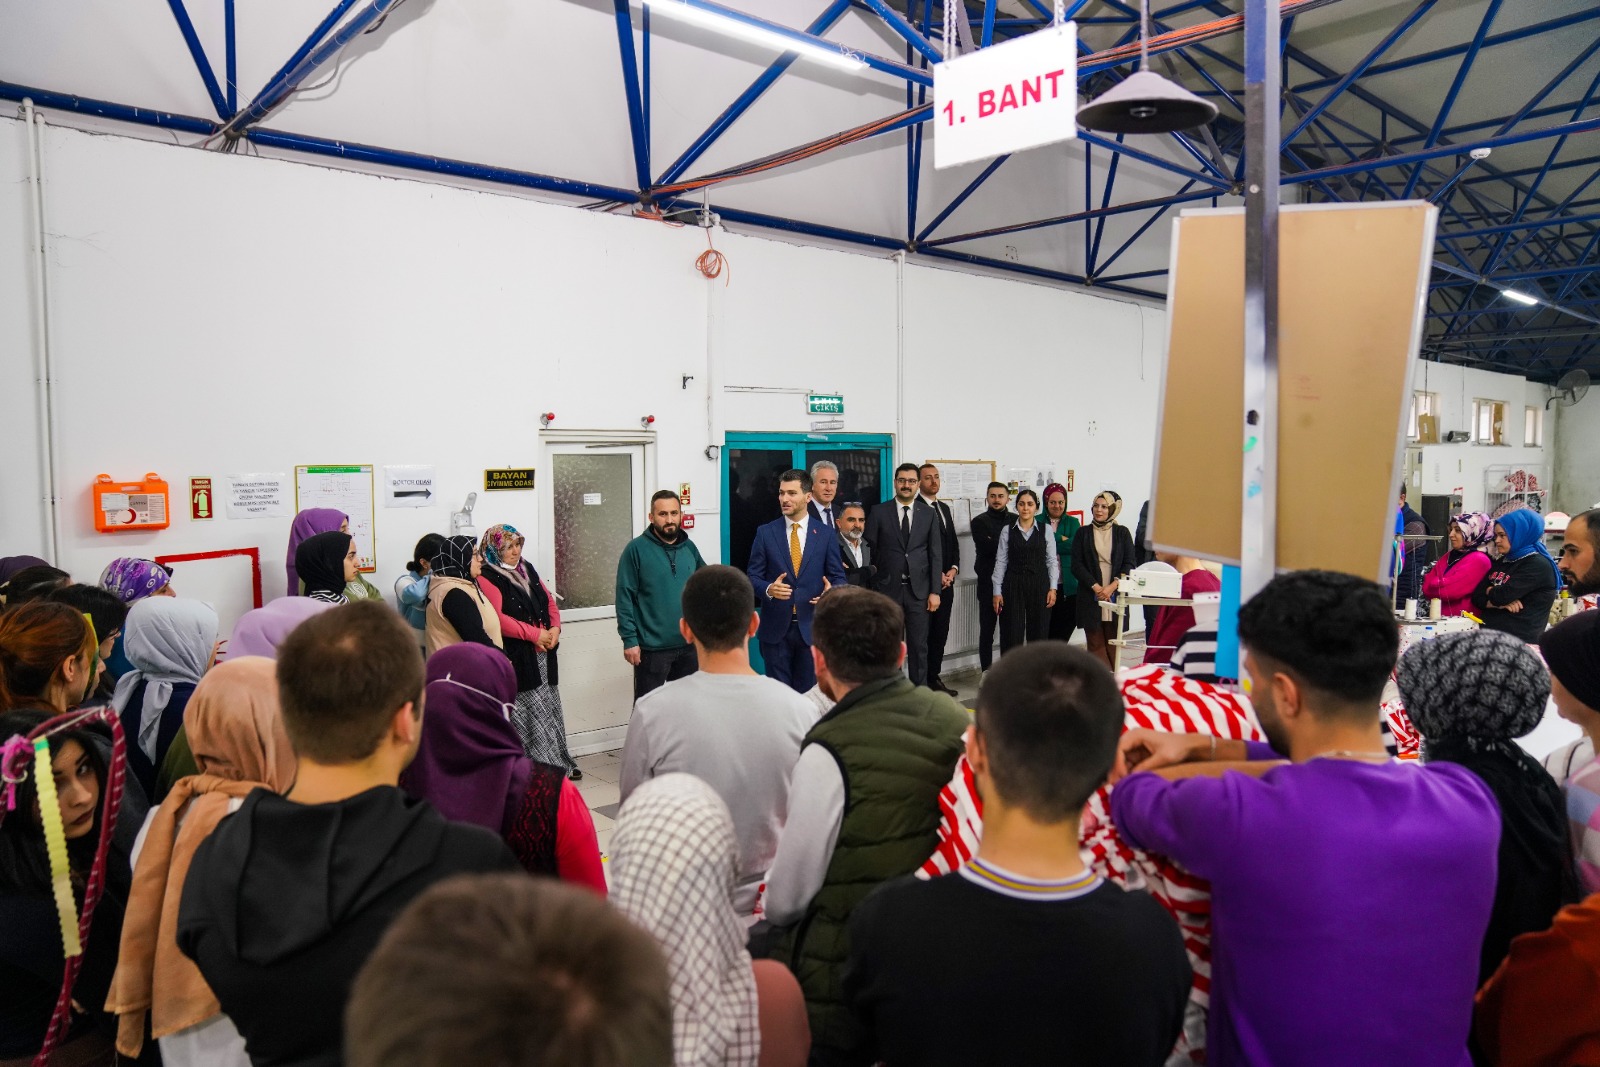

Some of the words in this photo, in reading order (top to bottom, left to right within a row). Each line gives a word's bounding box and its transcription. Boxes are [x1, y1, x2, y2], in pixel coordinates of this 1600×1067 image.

[943, 99, 965, 127] 1.
[978, 68, 1065, 118] BANT
[815, 404, 839, 413] ÇIKIŞ
[493, 471, 527, 480] BAYAN
